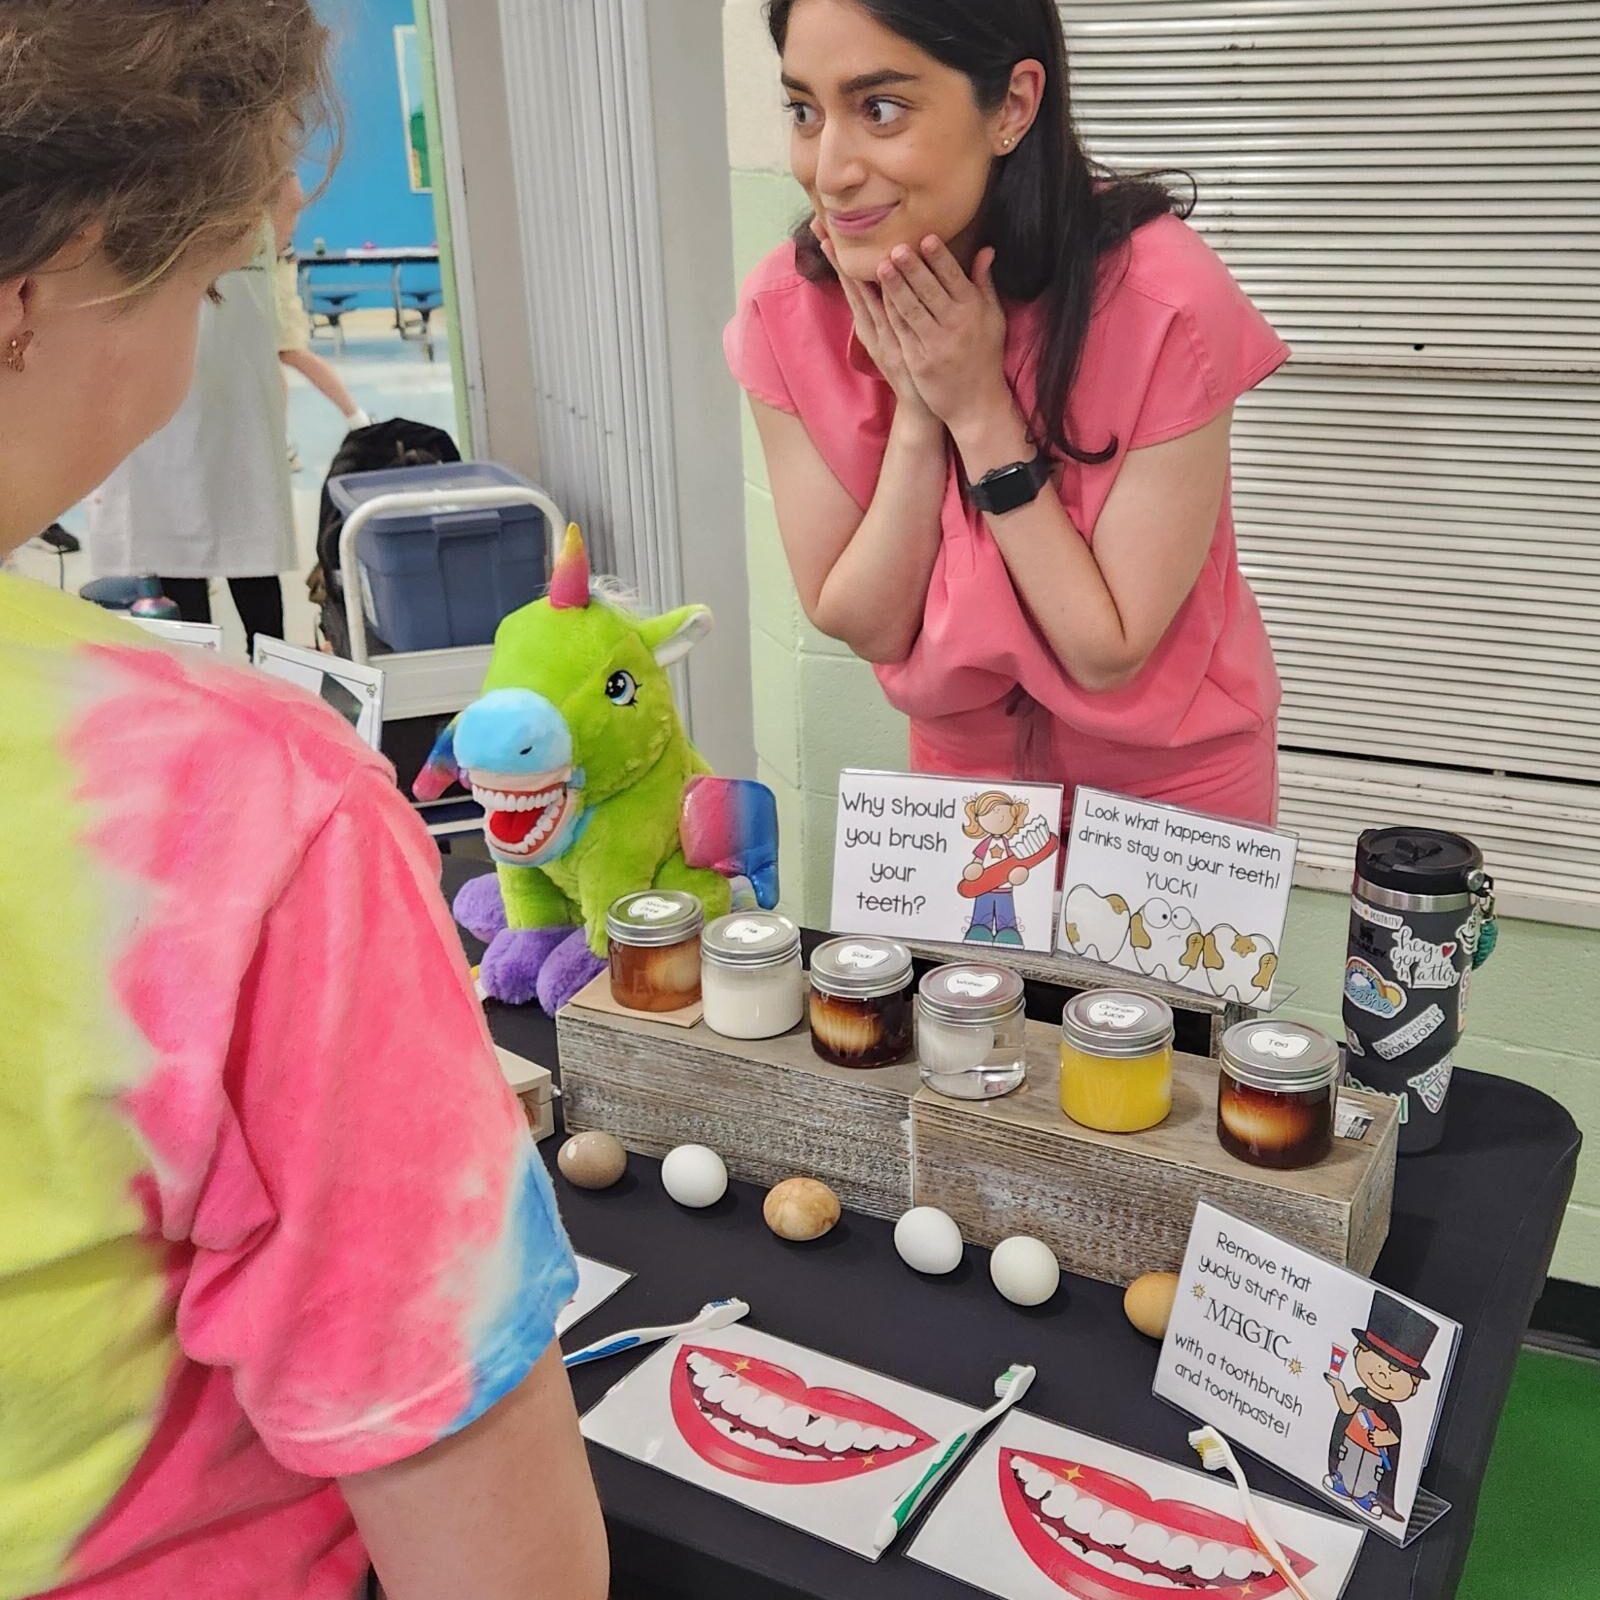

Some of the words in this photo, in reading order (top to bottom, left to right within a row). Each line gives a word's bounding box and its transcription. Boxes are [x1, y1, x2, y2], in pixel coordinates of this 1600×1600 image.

[842, 791, 885, 818] Why
[891, 795, 957, 819] should
[1084, 799, 1121, 822] Look
[1124, 812, 1161, 833] what
[1164, 818, 1231, 849] happens
[1236, 838, 1281, 862] when
[844, 827, 881, 848] you
[888, 827, 948, 853] brush
[1078, 825, 1122, 850] drinks
[1127, 839, 1160, 863] stay
[1163, 850, 1183, 866] on
[1186, 854, 1225, 875] your
[1228, 862, 1281, 889] teeth!
[869, 862, 917, 883] your
[1146, 871, 1198, 899] YUCK!
[856, 891, 927, 917] teeth?
[1268, 1038, 1289, 1049] Tea
[1380, 1040, 1415, 1059] WORK
[1412, 1022, 1435, 1041] FOR
[1433, 1012, 1444, 1026] IT
[1216, 1231, 1277, 1275] Remove
[1281, 1265, 1312, 1293] that
[1198, 1255, 1242, 1290] yucky
[1244, 1278, 1289, 1311] stuff
[1291, 1299, 1318, 1326] like
[1203, 1296, 1293, 1367] MAGIC
[1174, 1332, 1204, 1361] with
[1206, 1352, 1217, 1366] a
[1219, 1355, 1303, 1417] toothbrush
[1174, 1363, 1203, 1386] and
[1204, 1376, 1291, 1439] toothpaste!
